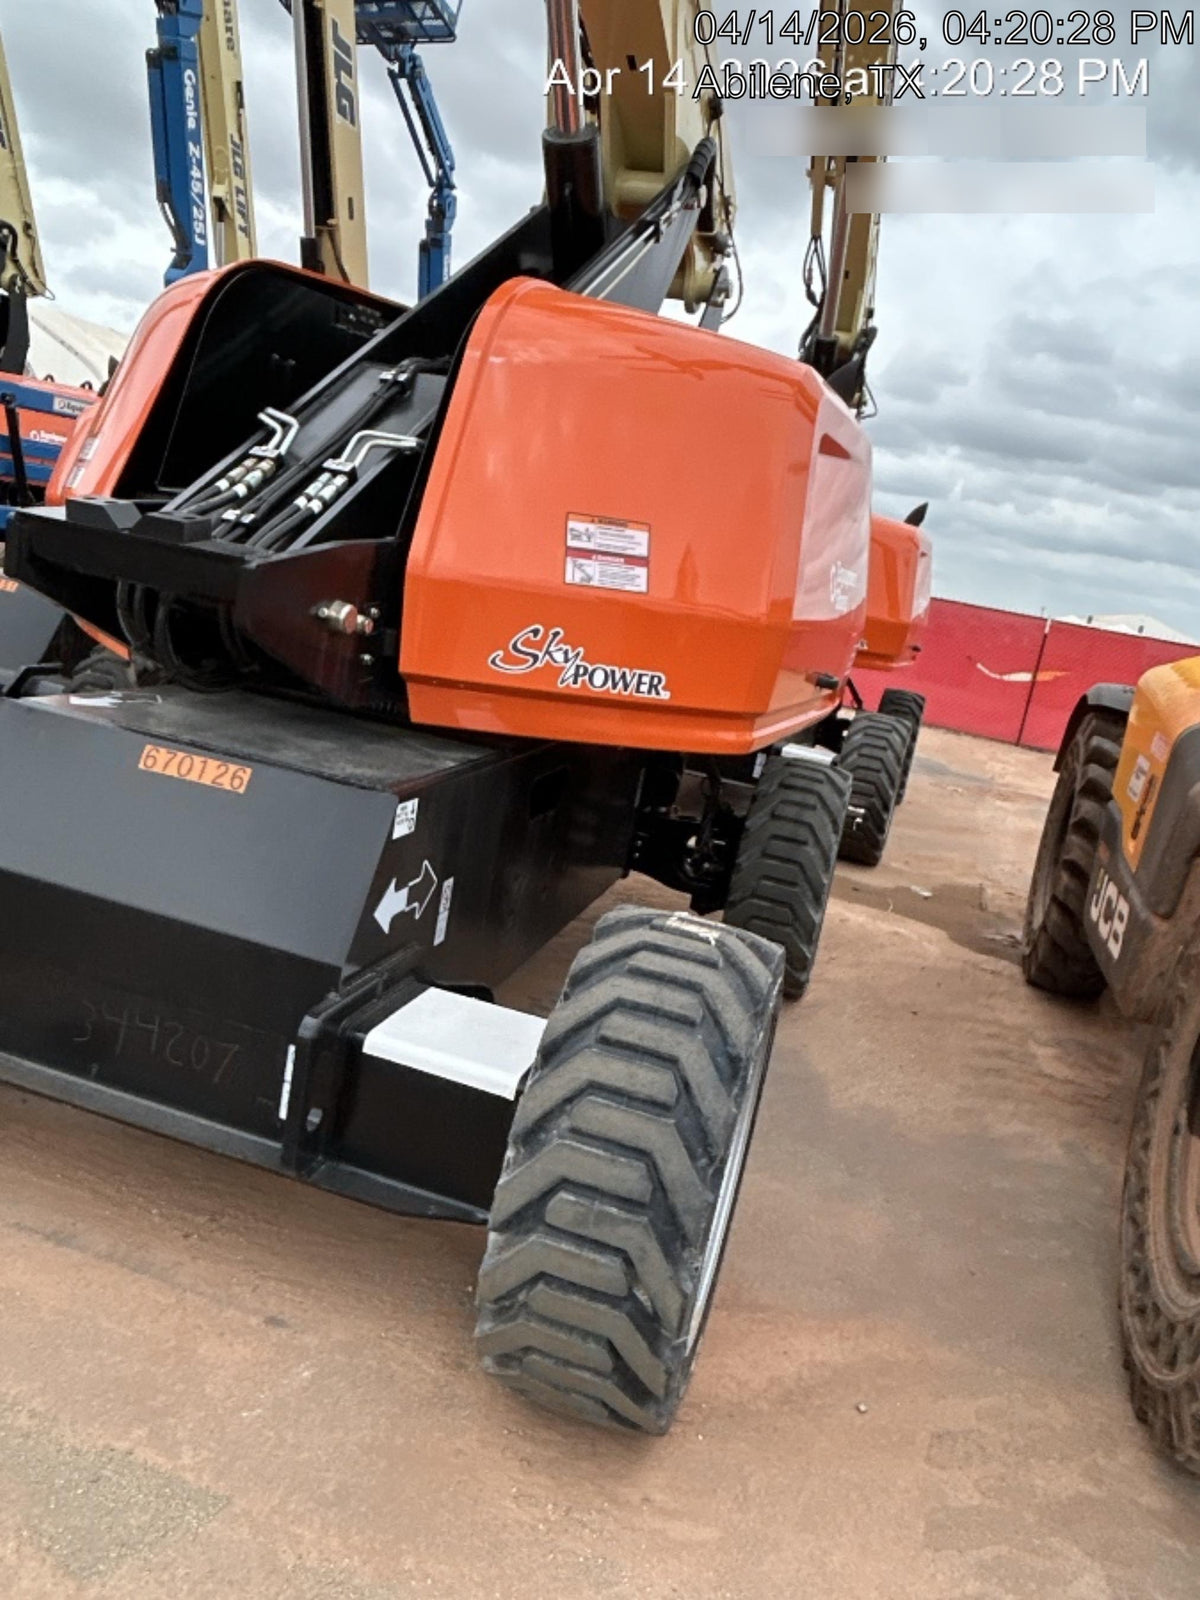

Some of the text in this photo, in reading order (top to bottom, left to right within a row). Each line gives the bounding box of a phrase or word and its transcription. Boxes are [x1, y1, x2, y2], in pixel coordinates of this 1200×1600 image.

[184, 68, 198, 130] Genie
[331, 16, 356, 129] JLG
[230, 133, 249, 239] JLG LIFT
[142, 746, 248, 791] 670126
[1090, 868, 1130, 960] JCB
[72, 1000, 240, 1084] 344207
